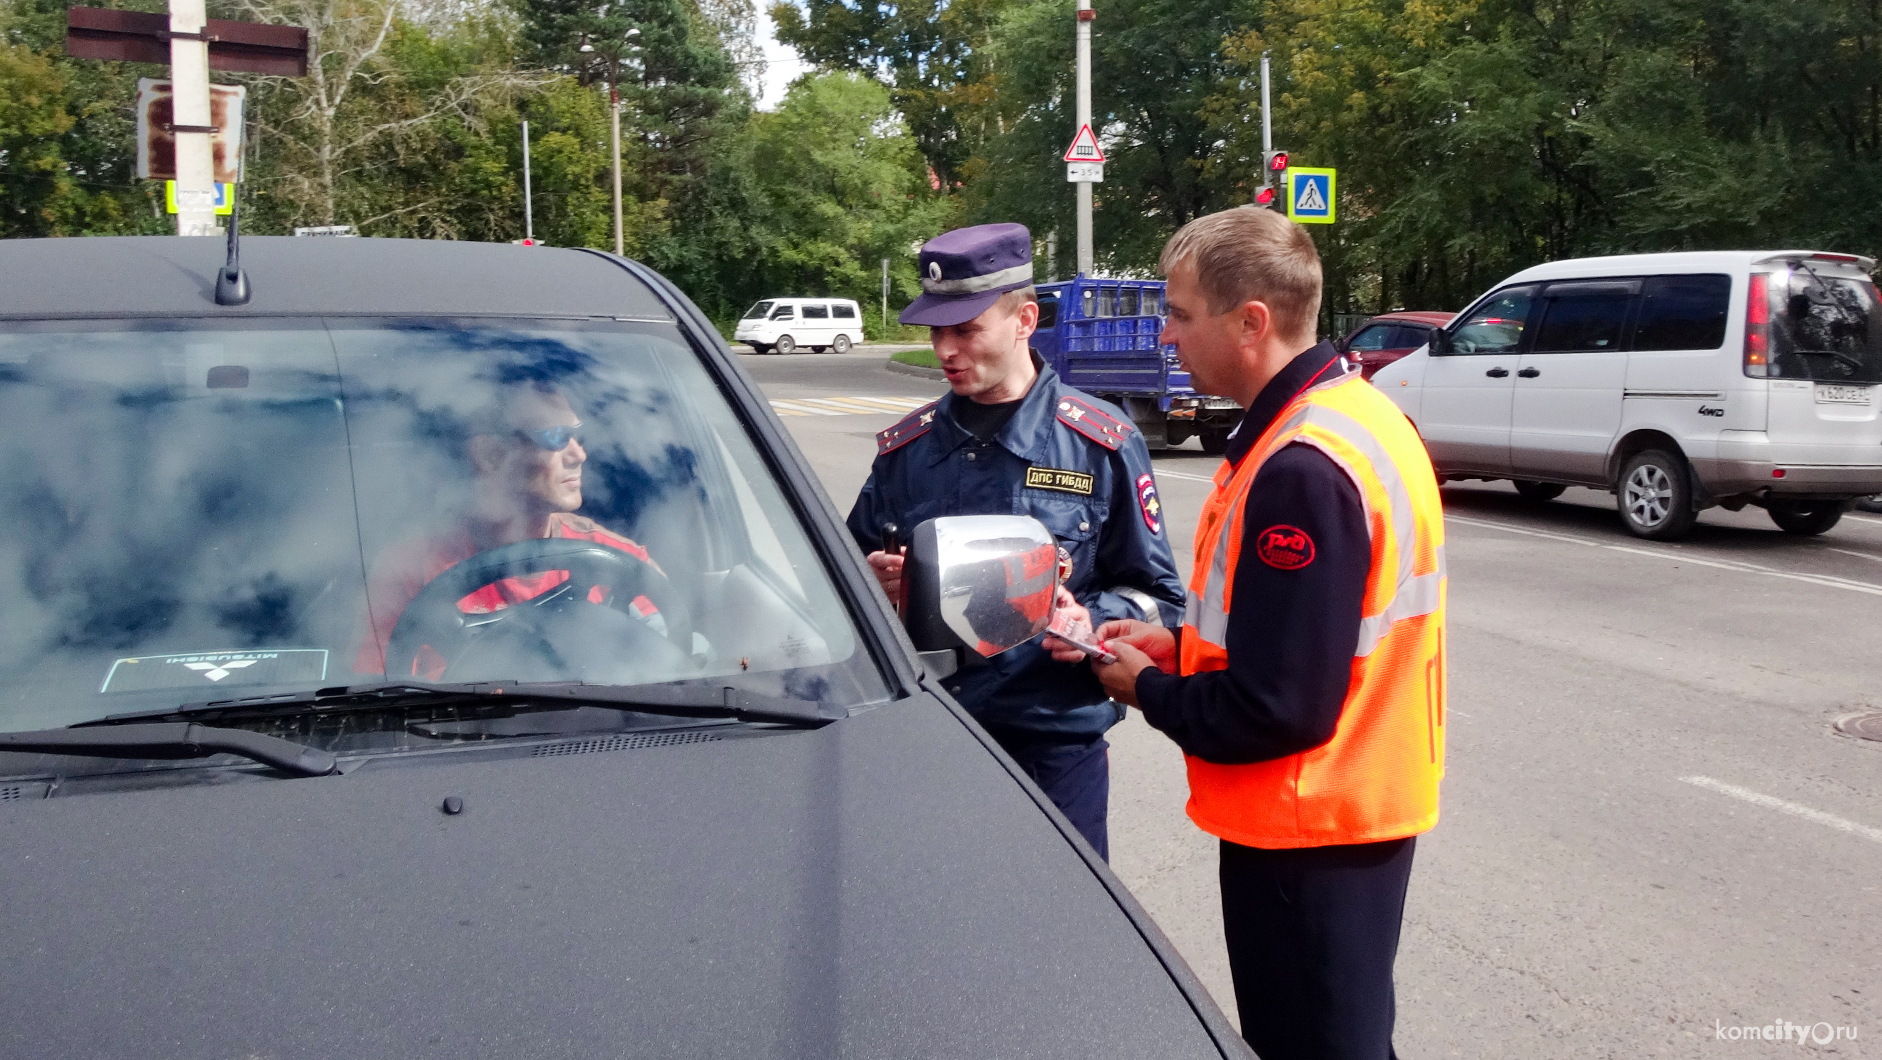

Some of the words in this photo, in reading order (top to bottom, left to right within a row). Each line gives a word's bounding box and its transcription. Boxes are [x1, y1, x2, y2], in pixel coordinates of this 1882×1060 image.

[1697, 405, 1724, 417] 4WD
[1030, 472, 1053, 484] ДПС
[1055, 474, 1090, 490] ГИБДД
[166, 653, 278, 664] MITSUBISHI
